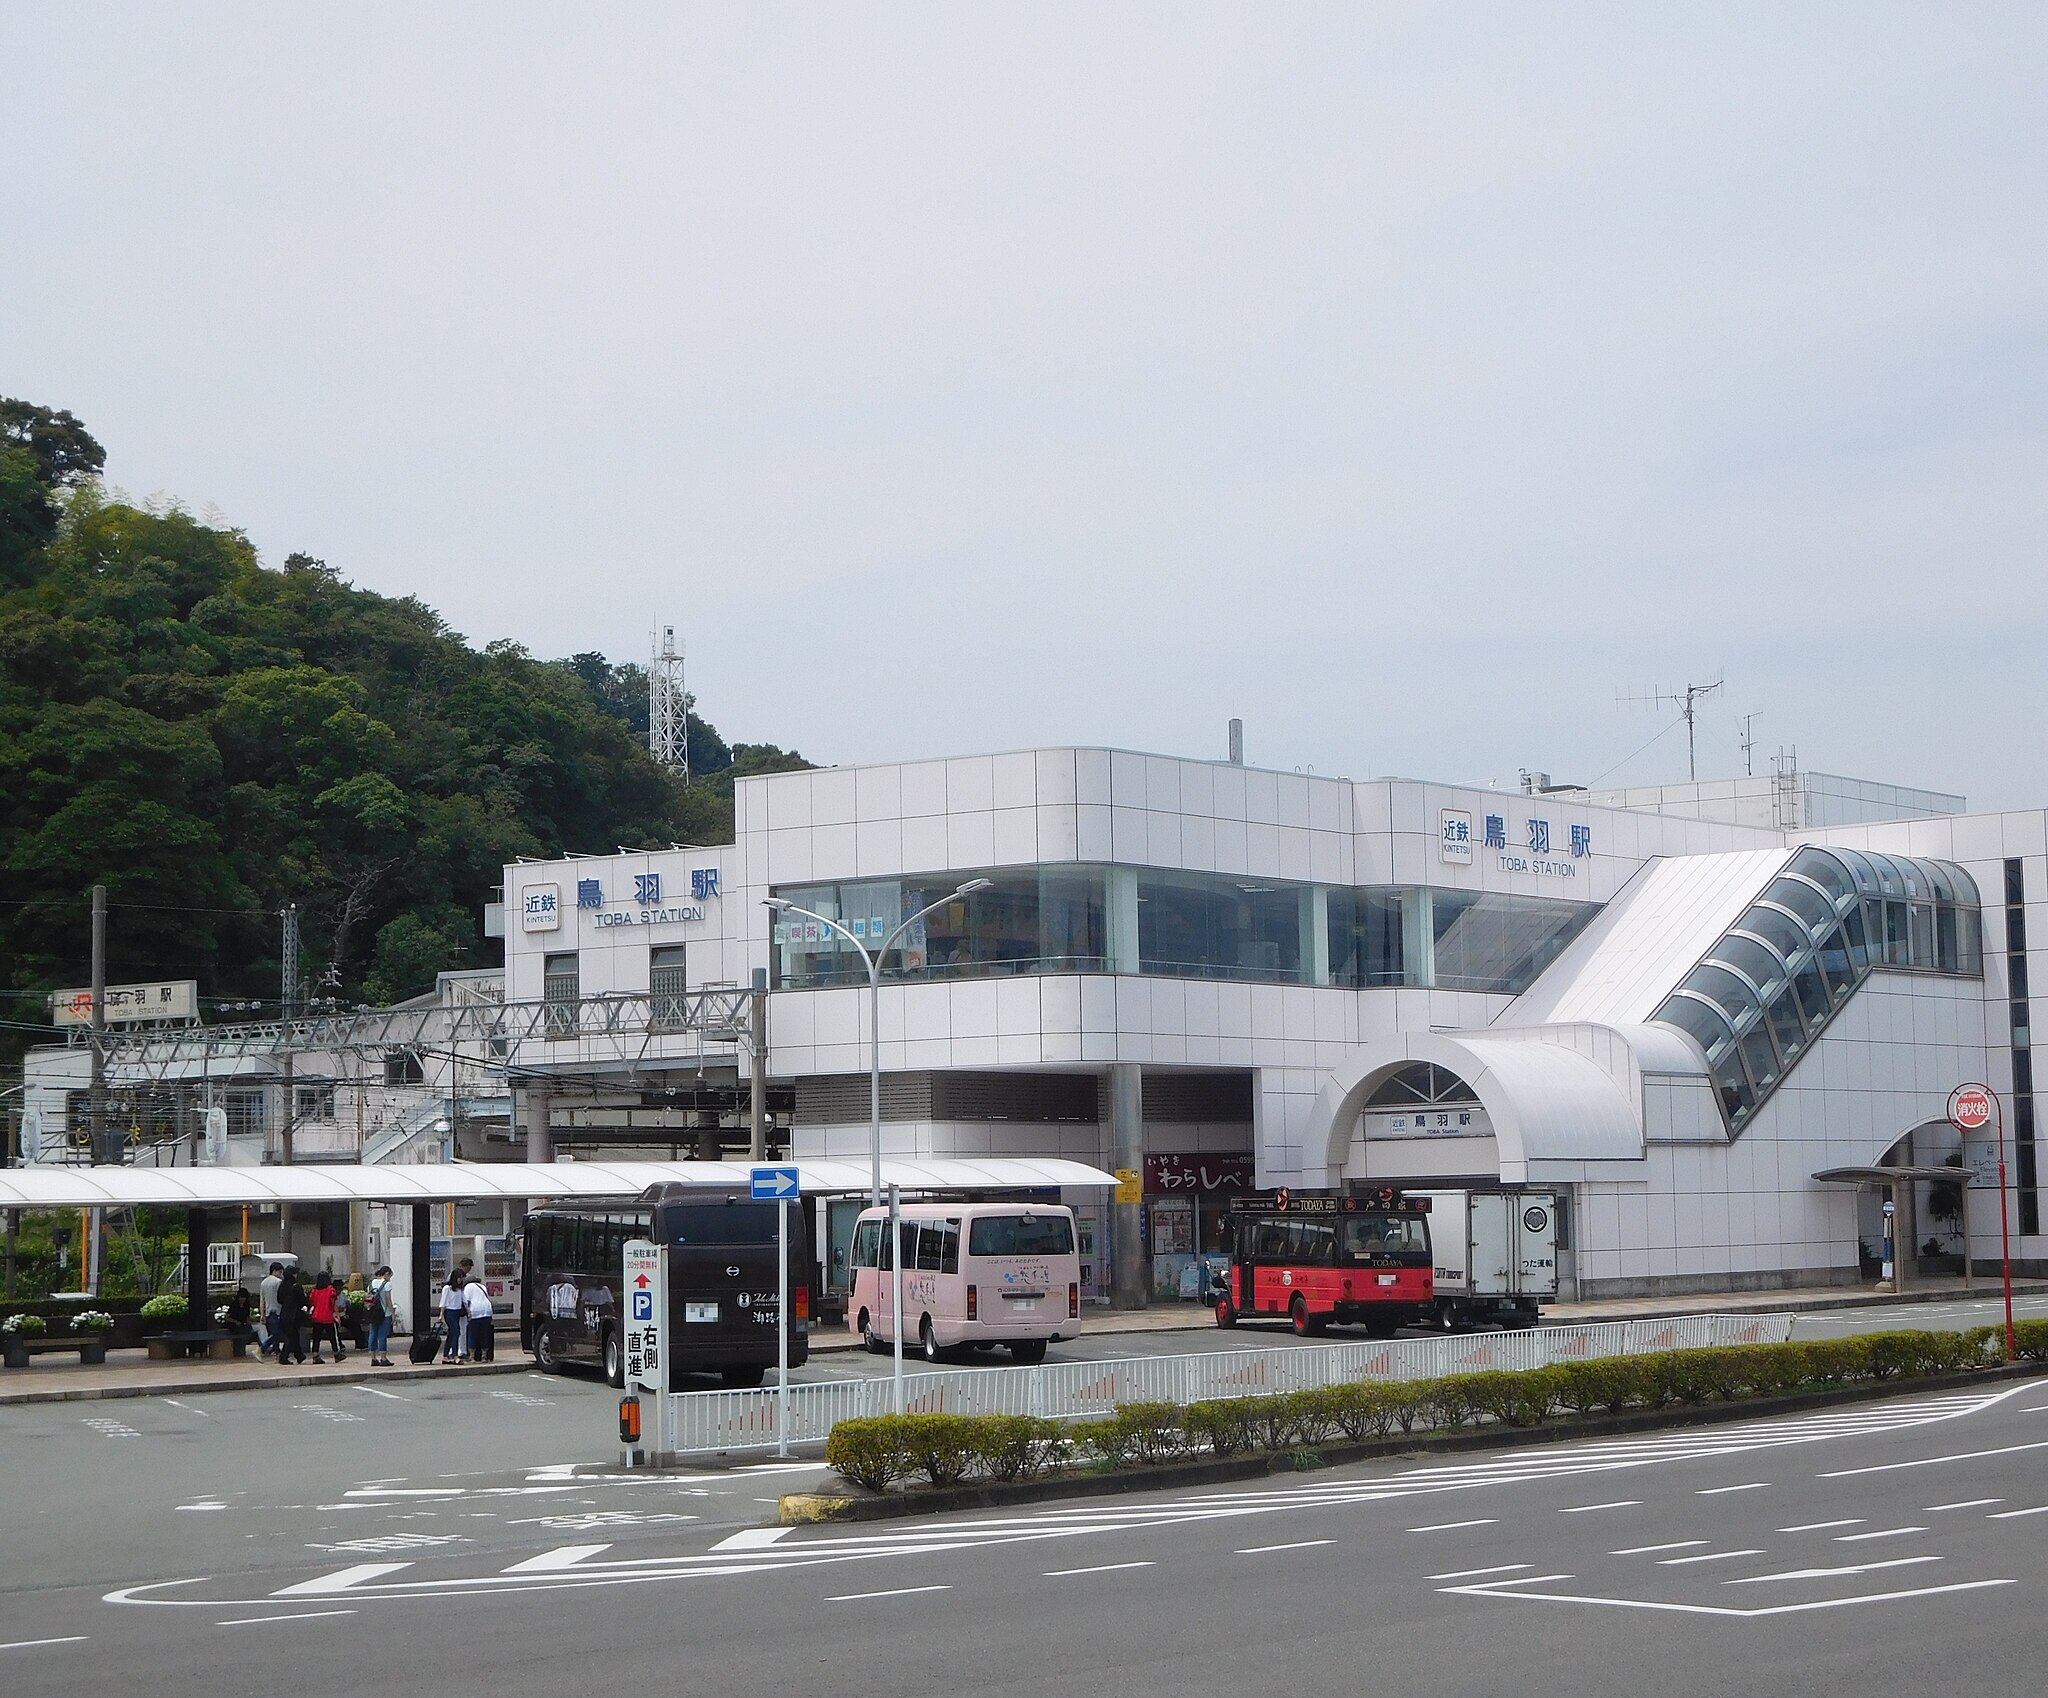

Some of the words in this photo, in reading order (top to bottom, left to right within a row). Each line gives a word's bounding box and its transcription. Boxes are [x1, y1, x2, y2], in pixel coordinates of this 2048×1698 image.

[1443, 819, 1470, 843] 近鉄
[1483, 814, 1592, 860] 鳥羽駅
[1443, 844, 1471, 855] KINTETSU
[1500, 856, 1529, 872] TOBA
[1532, 860, 1576, 877] STATION
[577, 868, 720, 909] 鳥羽駅
[525, 895, 557, 914] 近鉄
[526, 914, 556, 924] KINTETSU
[595, 912, 632, 927] TOBA
[640, 906, 702, 924] STATION
[1957, 1101, 1988, 1117] 消火栓
[1414, 1113, 1471, 1127] 鳥羽駅
[1157, 1166, 1242, 1190] わらしべ
[1300, 1200, 1324, 1211] TODAYA
[626, 1248, 658, 1259] 一般駐車場
[1371, 1259, 1403, 1267] TODAYA
[626, 1259, 657, 1270] 20分間無料
[1522, 1259, 1553, 1268] つた運輸
[635, 1295, 651, 1317] P
[627, 1331, 643, 1377] 直進
[643, 1324, 659, 1370] 右側
